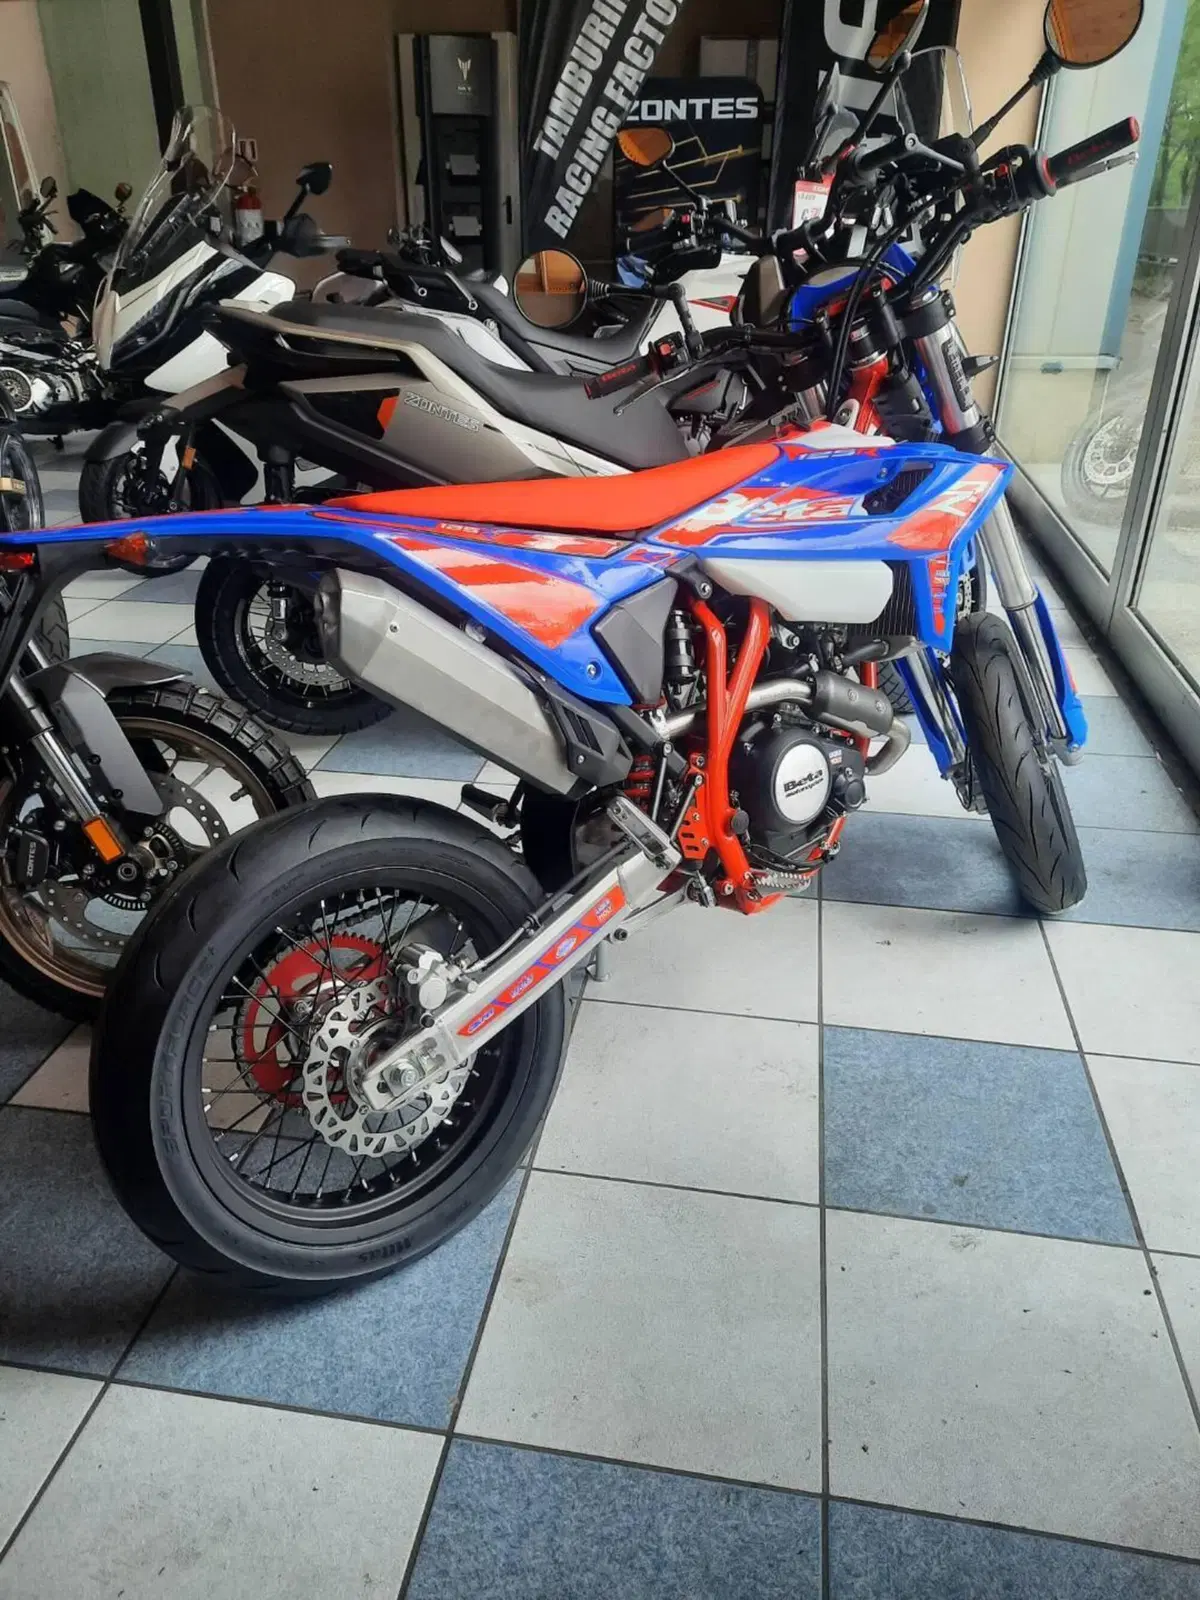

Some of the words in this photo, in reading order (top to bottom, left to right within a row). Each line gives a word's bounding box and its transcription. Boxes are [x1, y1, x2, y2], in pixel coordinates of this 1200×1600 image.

[544, 105, 622, 240] RACING
[603, 0, 684, 109] FACTO
[404, 391, 481, 432] ZONTES
[783, 769, 823, 793] Beta
[26, 841, 37, 878] ZONTES
